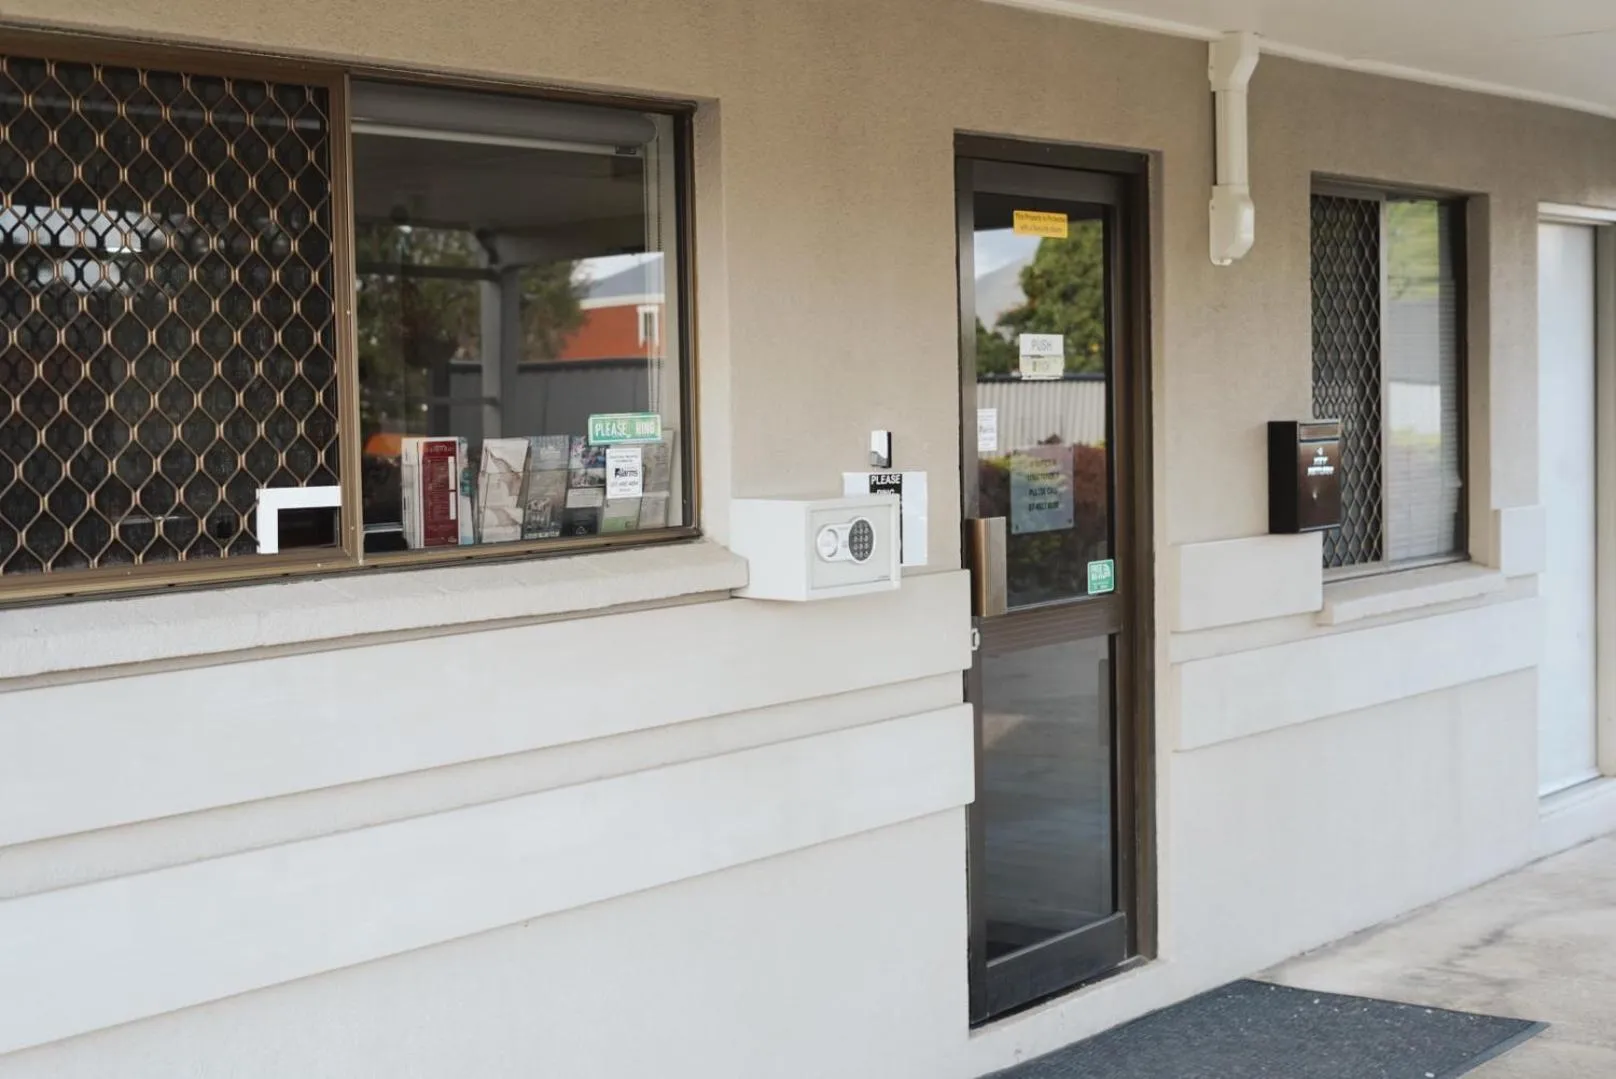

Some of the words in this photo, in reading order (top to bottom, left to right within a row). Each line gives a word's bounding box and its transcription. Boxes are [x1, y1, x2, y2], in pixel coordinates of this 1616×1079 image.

[1030, 338, 1052, 352] PUSH
[595, 421, 628, 438] PLEASE
[636, 421, 655, 434] RING
[871, 475, 900, 485] PLEASE
